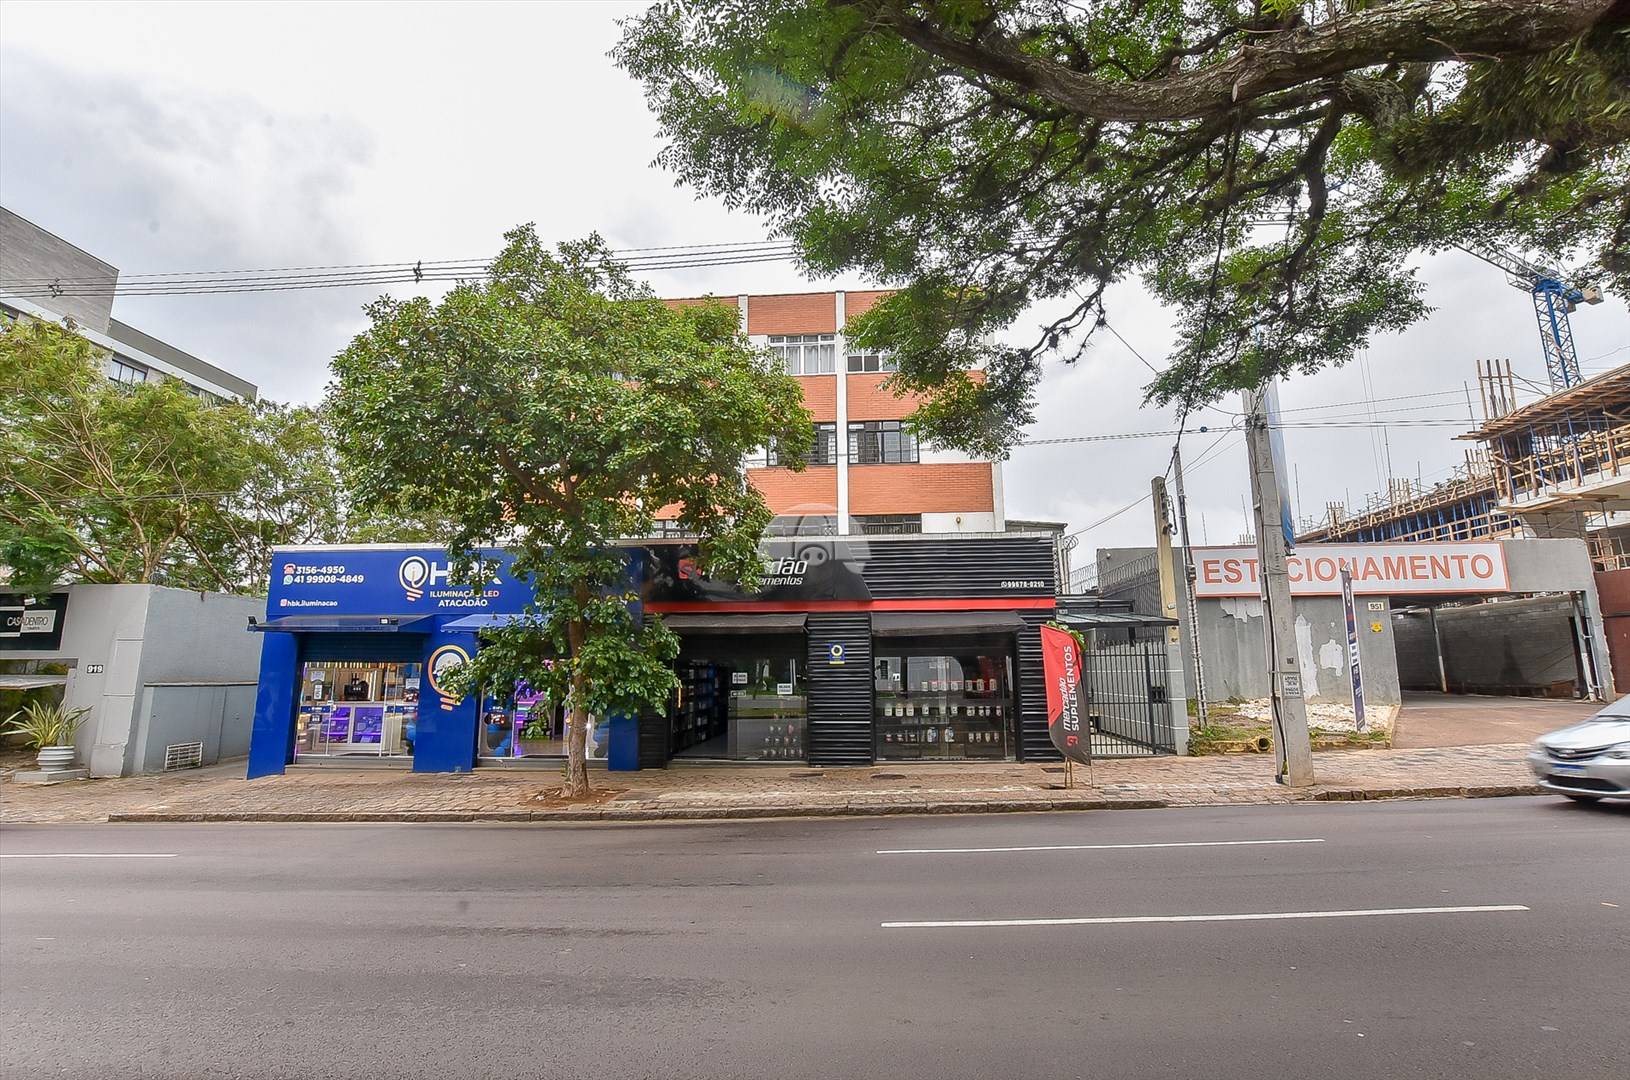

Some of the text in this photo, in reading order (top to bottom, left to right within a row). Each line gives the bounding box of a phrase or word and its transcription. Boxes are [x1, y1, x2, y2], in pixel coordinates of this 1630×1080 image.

[296, 566, 345, 574] 3156-4950
[1202, 553, 1494, 584] ESTCIONAMENTO
[294, 574, 365, 584] 41 99908-4849
[736, 576, 804, 586] sementos
[483, 590, 500, 598] LED
[438, 597, 488, 607] ATACADÃO
[1063, 645, 1080, 732] SUPLEMENTOS
[1059, 677, 1072, 732] mercadão
